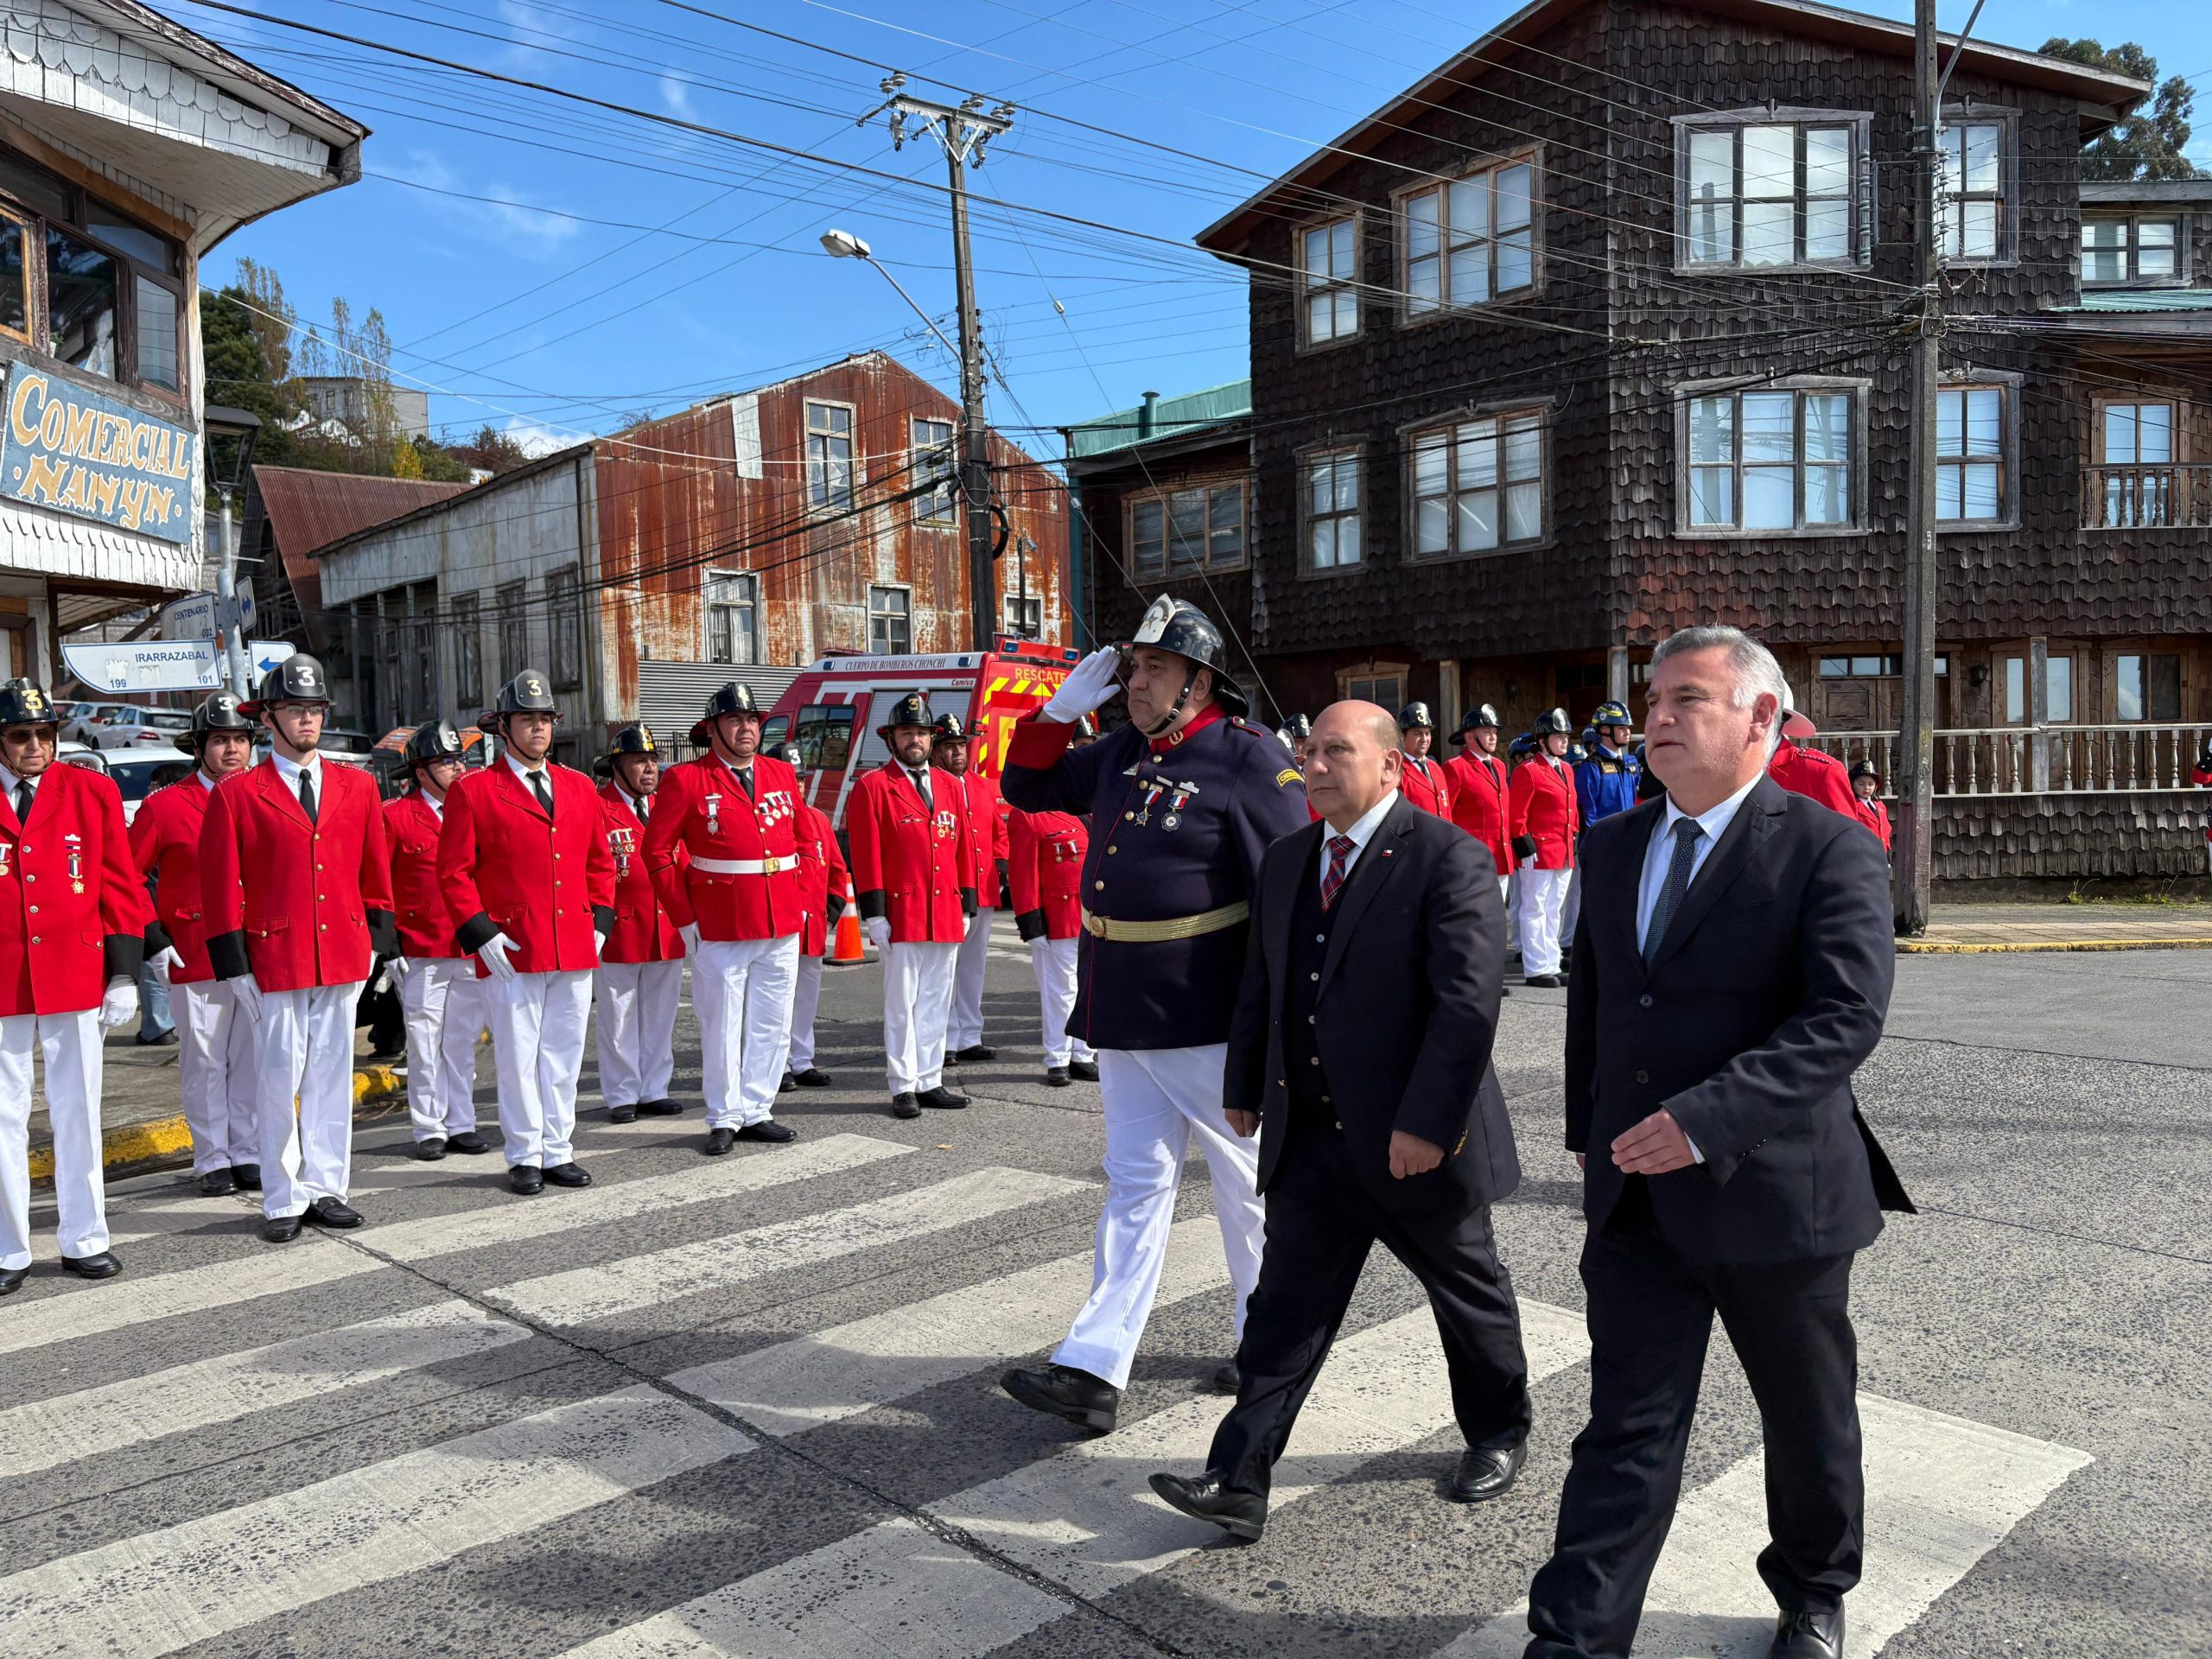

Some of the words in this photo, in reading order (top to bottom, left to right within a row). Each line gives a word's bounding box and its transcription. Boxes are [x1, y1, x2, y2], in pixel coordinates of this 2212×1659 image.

[10, 373, 191, 480] COMERCIAL
[174, 604, 209, 621] CENTENARIO
[201, 627, 213, 638] 002
[135, 650, 209, 664] IRARRAZABAL
[846, 660, 869, 671] CUERPO
[869, 660, 879, 670] DE
[880, 659, 914, 670] BOMBEROS
[914, 658, 946, 669] CHONCHI
[197, 675, 213, 685] 101
[296, 666, 315, 687] 3
[1014, 667, 1066, 684] RESCATE
[109, 677, 127, 690] 199
[526, 679, 543, 696] 3
[21, 689, 44, 710] 3
[218, 696, 234, 711] 3
[908, 698, 918, 710] 3
[1416, 709, 1427, 722] 3
[448, 730, 460, 745] 3
[788, 748, 801, 765] 3
